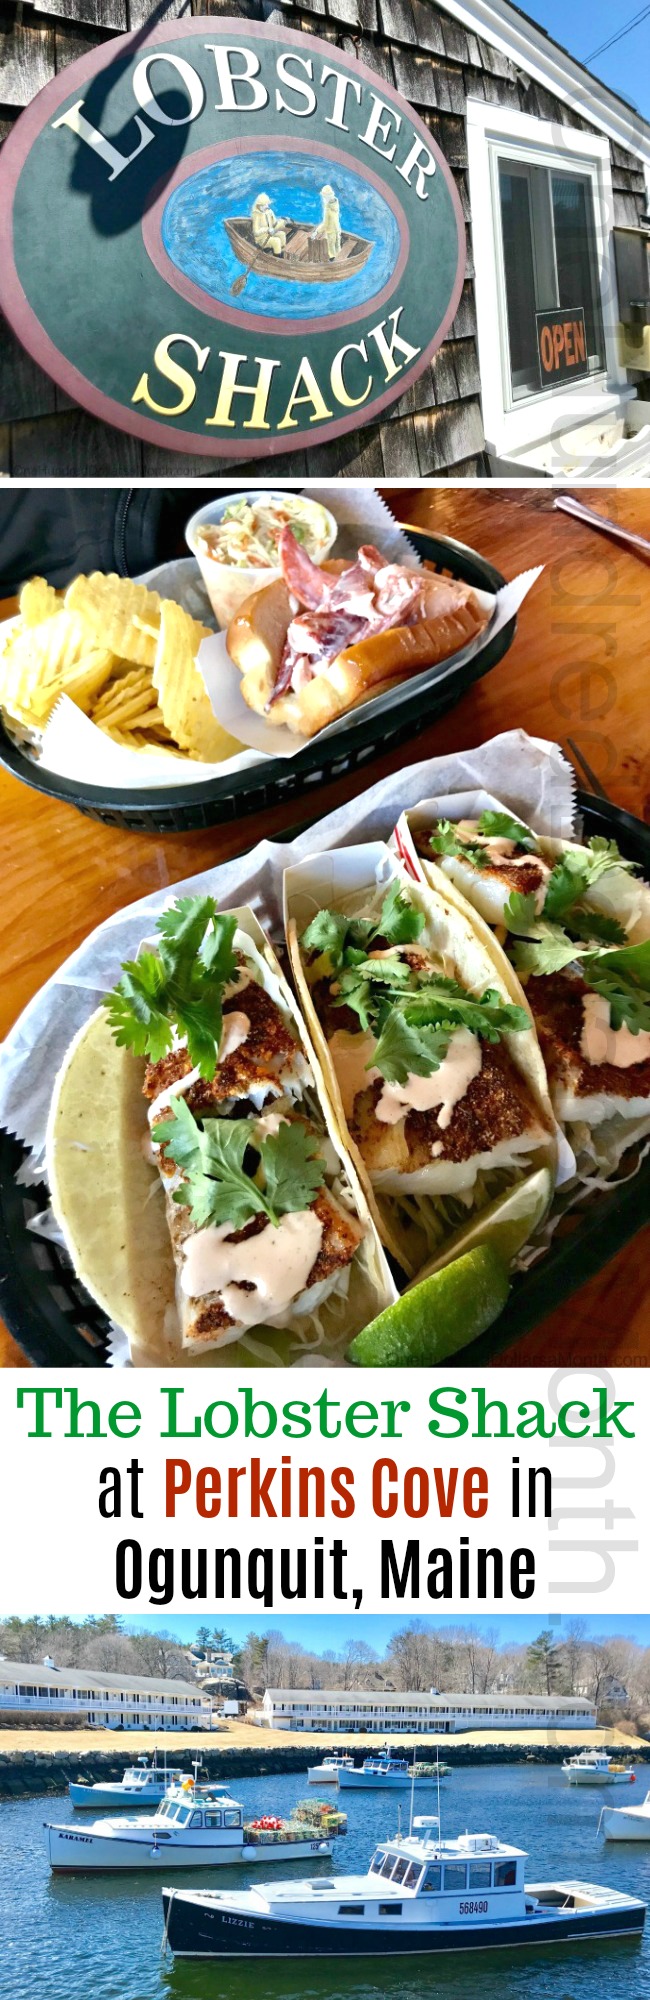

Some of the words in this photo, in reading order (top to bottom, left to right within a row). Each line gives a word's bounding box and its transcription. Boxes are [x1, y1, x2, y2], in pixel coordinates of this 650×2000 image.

[51, 43, 437, 200] LOBSTER
[541, 321, 586, 372] OPEN
[131, 305, 421, 430] SHACK
[58, 1833, 94, 1844] KARAMEL
[221, 1915, 255, 1929] LIZZIE
[459, 1901, 488, 1915] 568490
